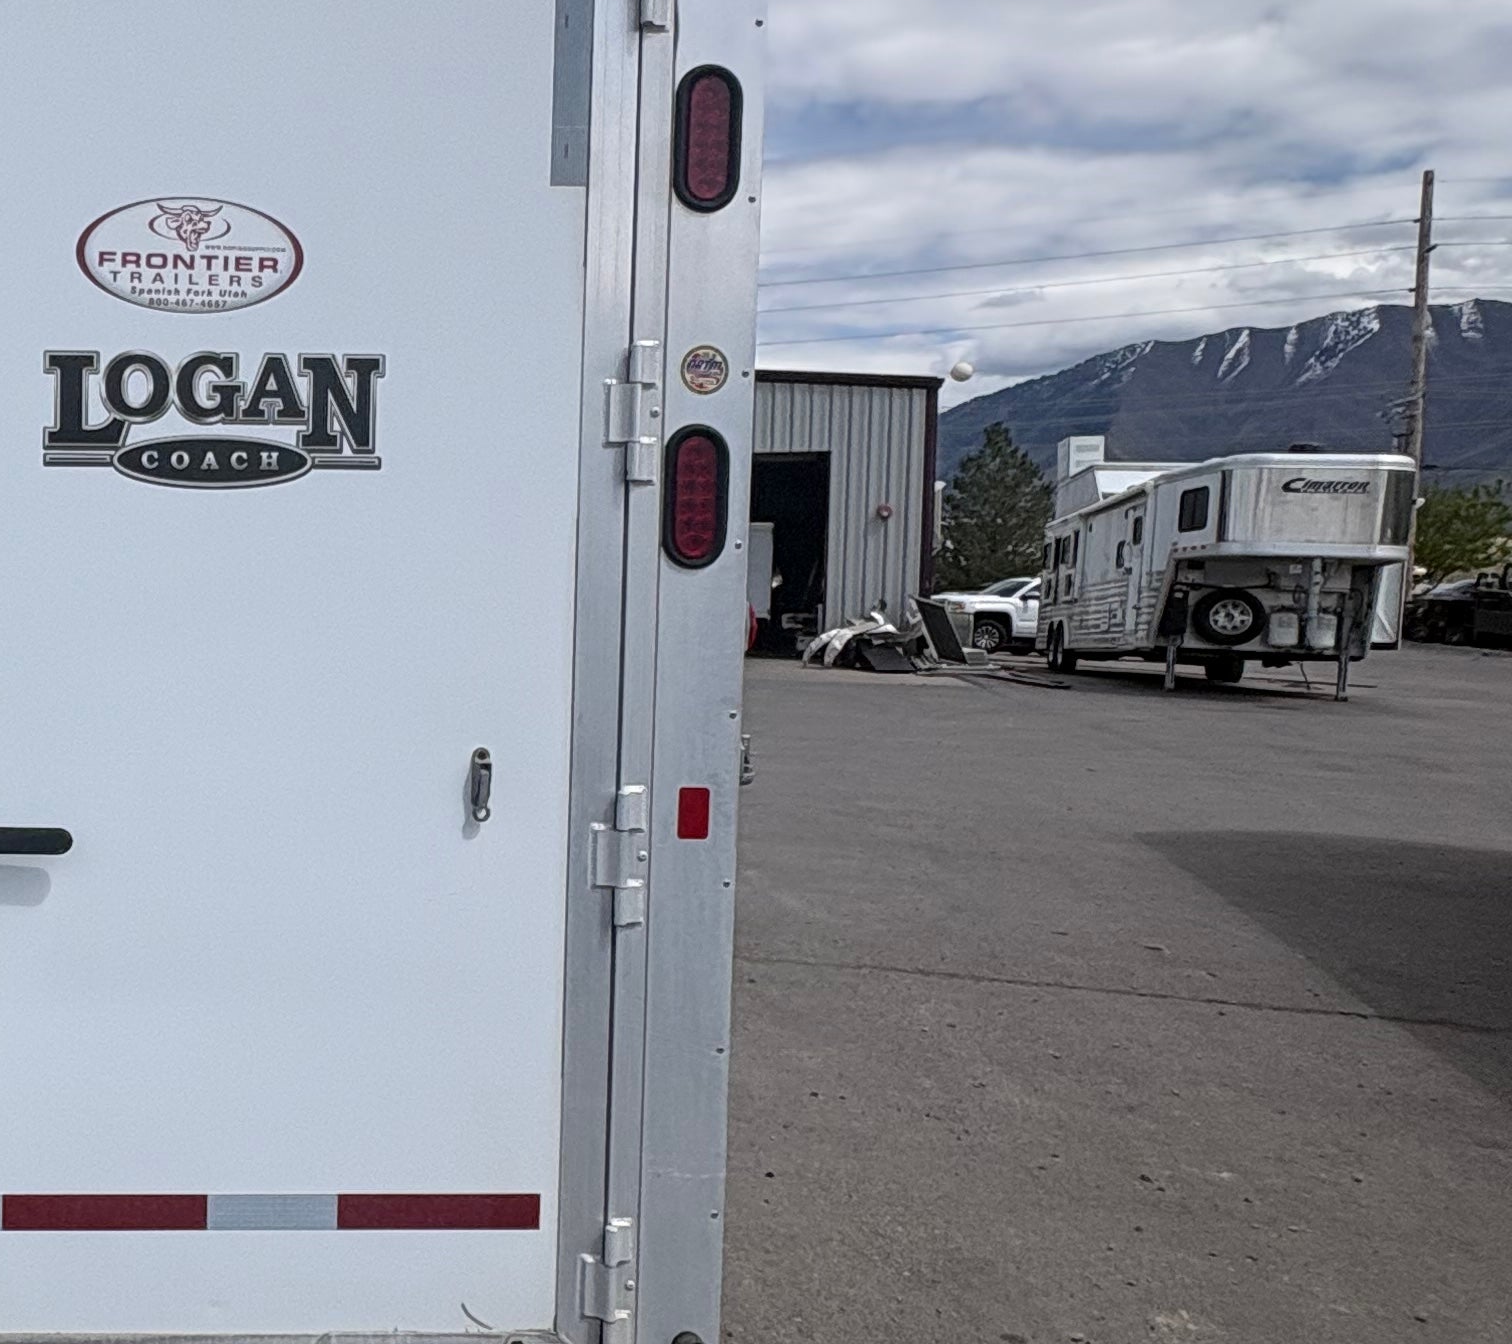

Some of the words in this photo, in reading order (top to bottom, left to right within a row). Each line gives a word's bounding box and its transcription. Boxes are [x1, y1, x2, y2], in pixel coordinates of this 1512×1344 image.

[98, 250, 280, 274] FRONTIER
[109, 270, 264, 289] TRAILERS
[130, 285, 181, 298] Spanish
[186, 287, 214, 298] Fork
[218, 288, 248, 299] Utah
[43, 349, 386, 454] LOGAN
[140, 451, 281, 471] COACH
[1281, 477, 1371, 494] Cimarron
